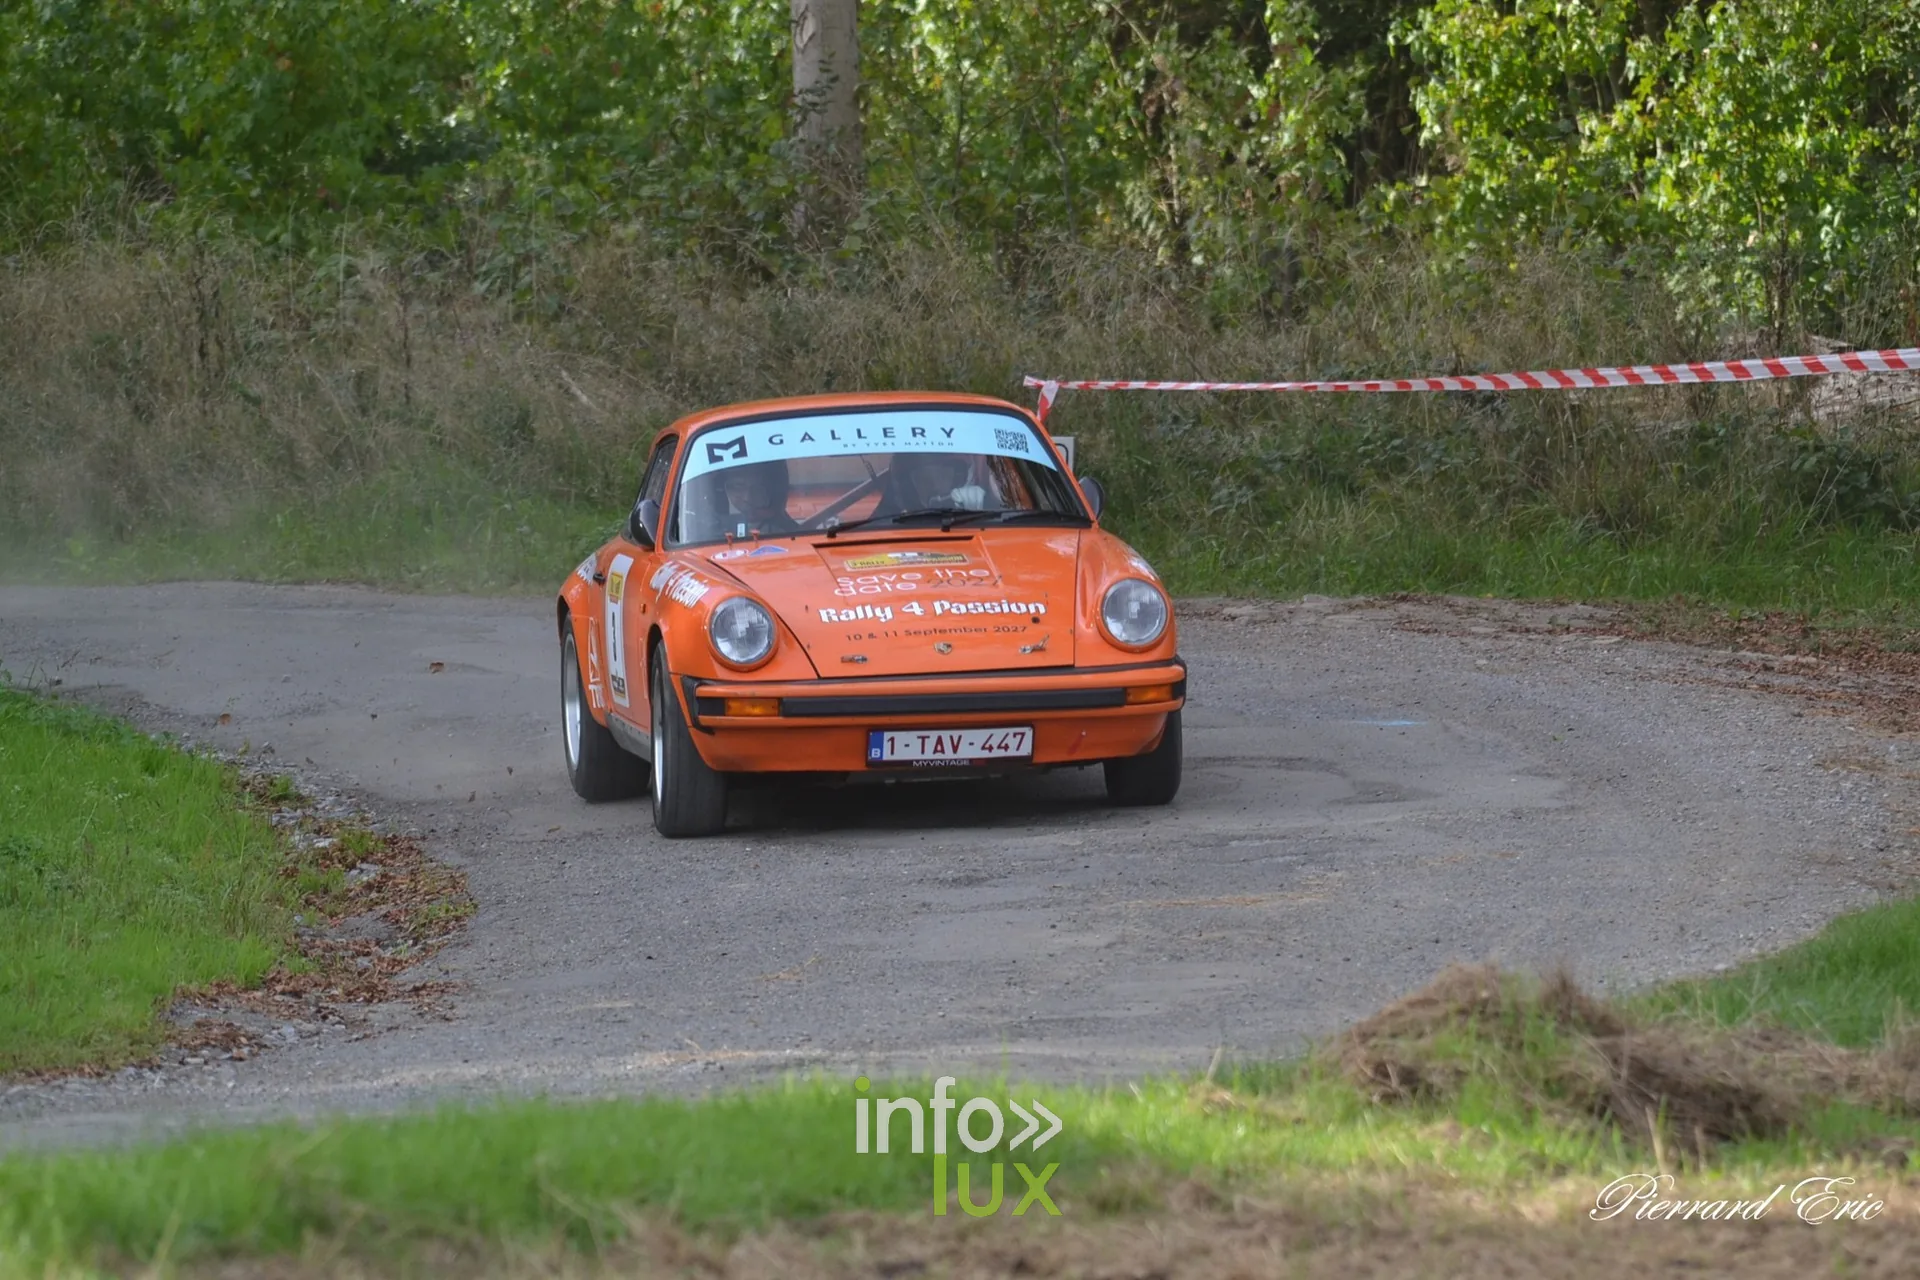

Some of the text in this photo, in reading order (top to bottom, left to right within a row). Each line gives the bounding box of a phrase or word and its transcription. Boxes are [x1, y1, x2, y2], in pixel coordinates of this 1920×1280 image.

[768, 426, 955, 447] GALLERY
[836, 568, 990, 587] save the
[833, 581, 917, 597] date
[818, 598, 1047, 624] Rally 4 Passion
[845, 634, 862, 642] 10
[883, 630, 899, 638] 11
[904, 626, 988, 638] September
[992, 625, 1028, 633] 2027
[871, 731, 1027, 759] B 1-TAV-447
[912, 759, 970, 768] MYVINTAGE
